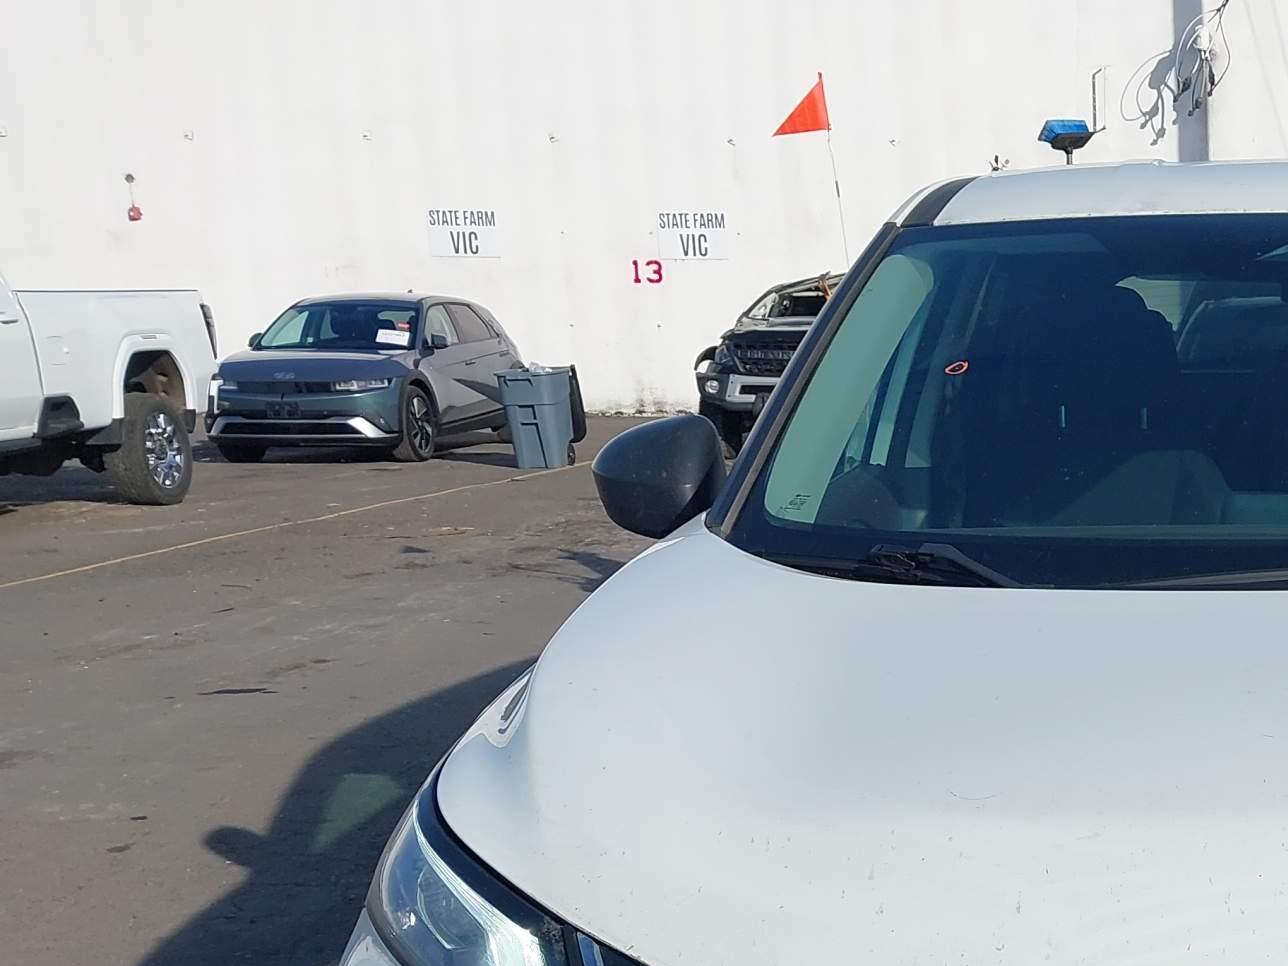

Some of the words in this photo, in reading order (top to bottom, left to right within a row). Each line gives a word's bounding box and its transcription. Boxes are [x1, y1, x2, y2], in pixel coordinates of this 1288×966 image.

[428, 209, 461, 226] STATE
[463, 210, 496, 227] FARM
[658, 213, 691, 229] STATE
[693, 213, 726, 229] FARM
[449, 230, 479, 255] VIC
[679, 233, 708, 257] VIC
[631, 259, 664, 284] 13
